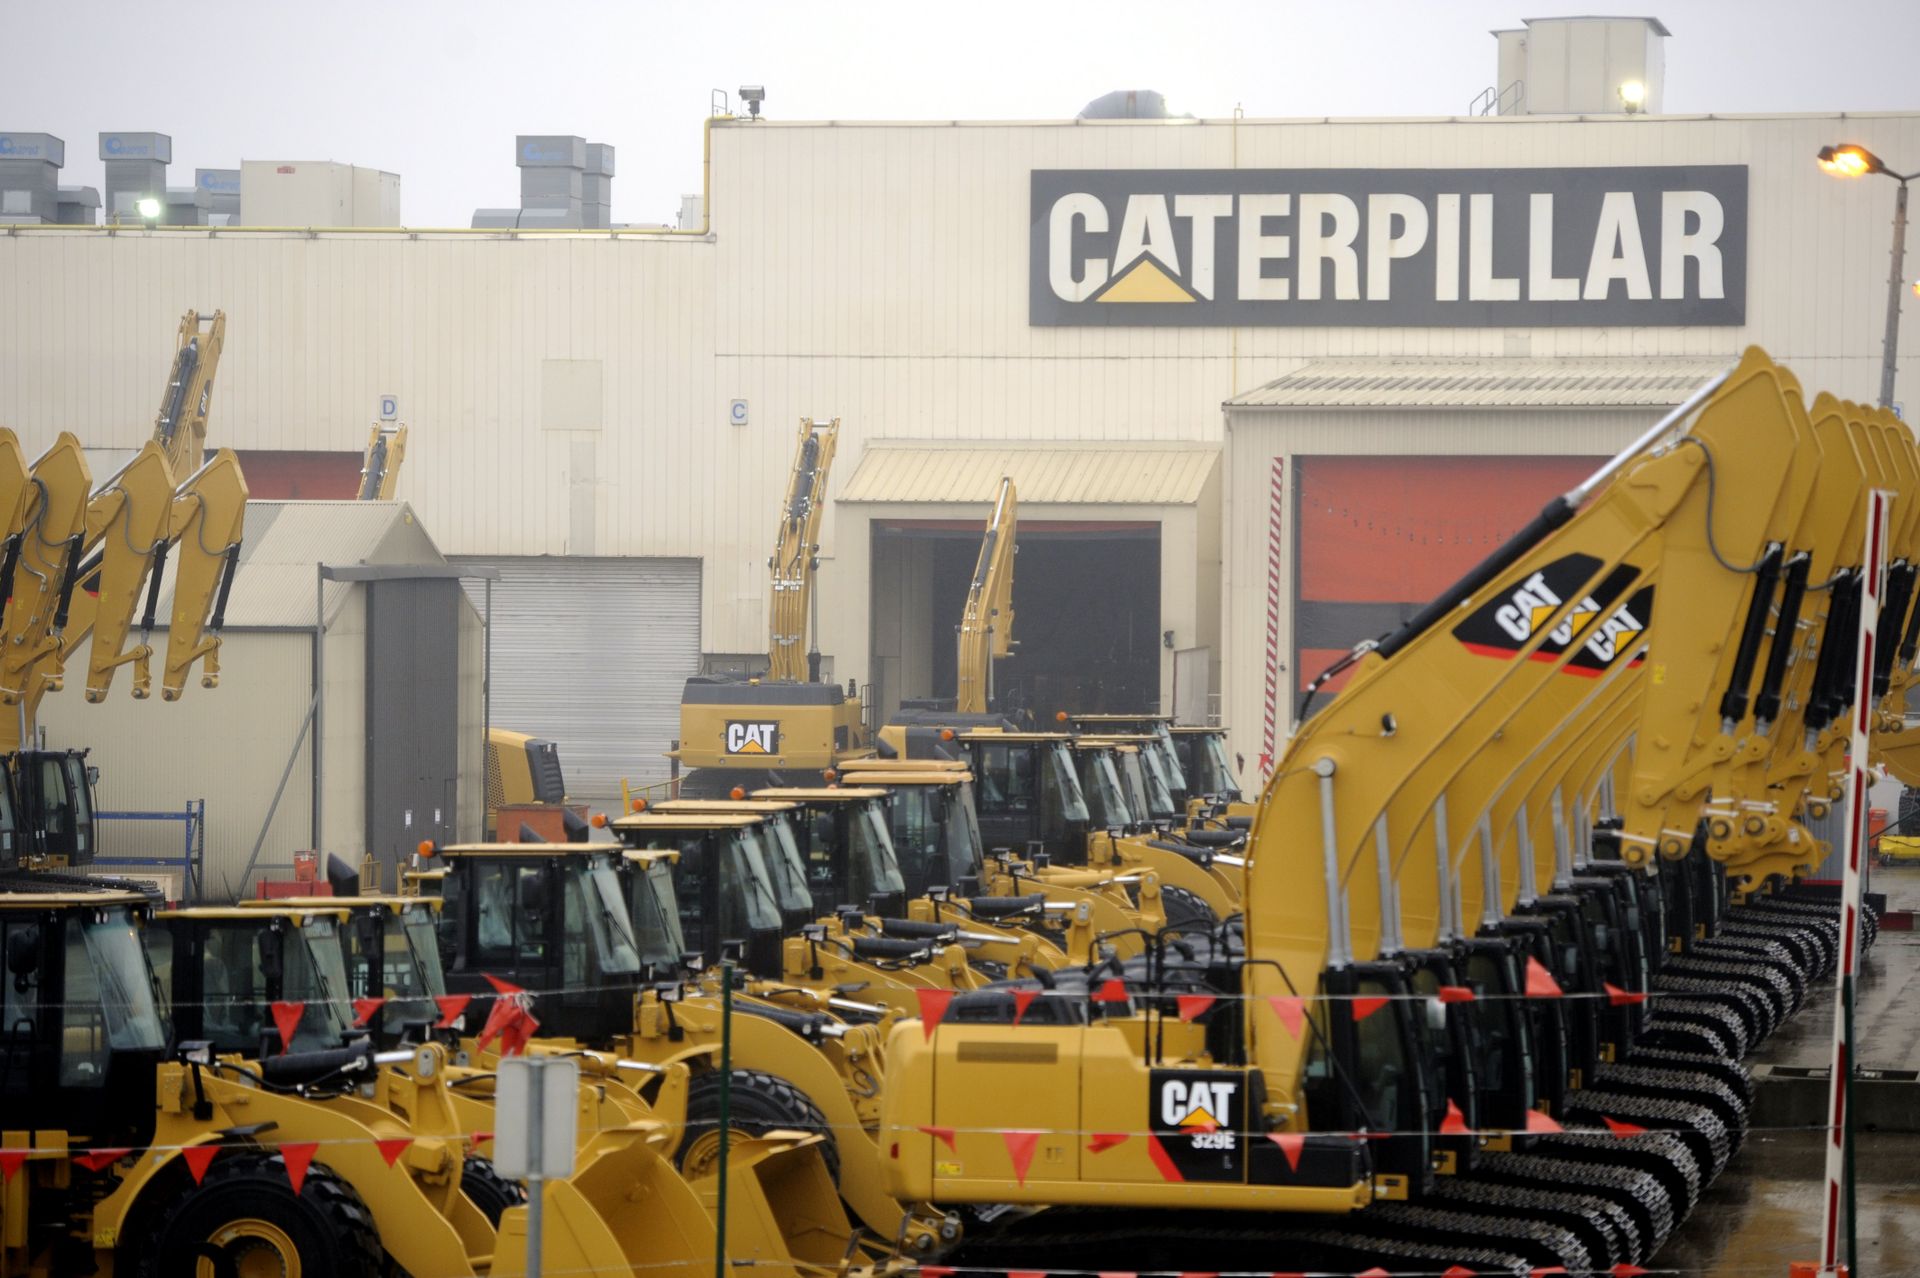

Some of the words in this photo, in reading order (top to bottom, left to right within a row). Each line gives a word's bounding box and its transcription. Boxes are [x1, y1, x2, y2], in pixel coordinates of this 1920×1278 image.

[1048, 190, 1725, 303] CATERPILLAR
[383, 399, 395, 415] D
[732, 403, 745, 419] C
[1495, 571, 1562, 642] CAT
[1585, 603, 1643, 662] CAT
[728, 723, 775, 753] CAT
[1161, 1080, 1237, 1127] CAT
[1191, 1130, 1236, 1149] 329E
